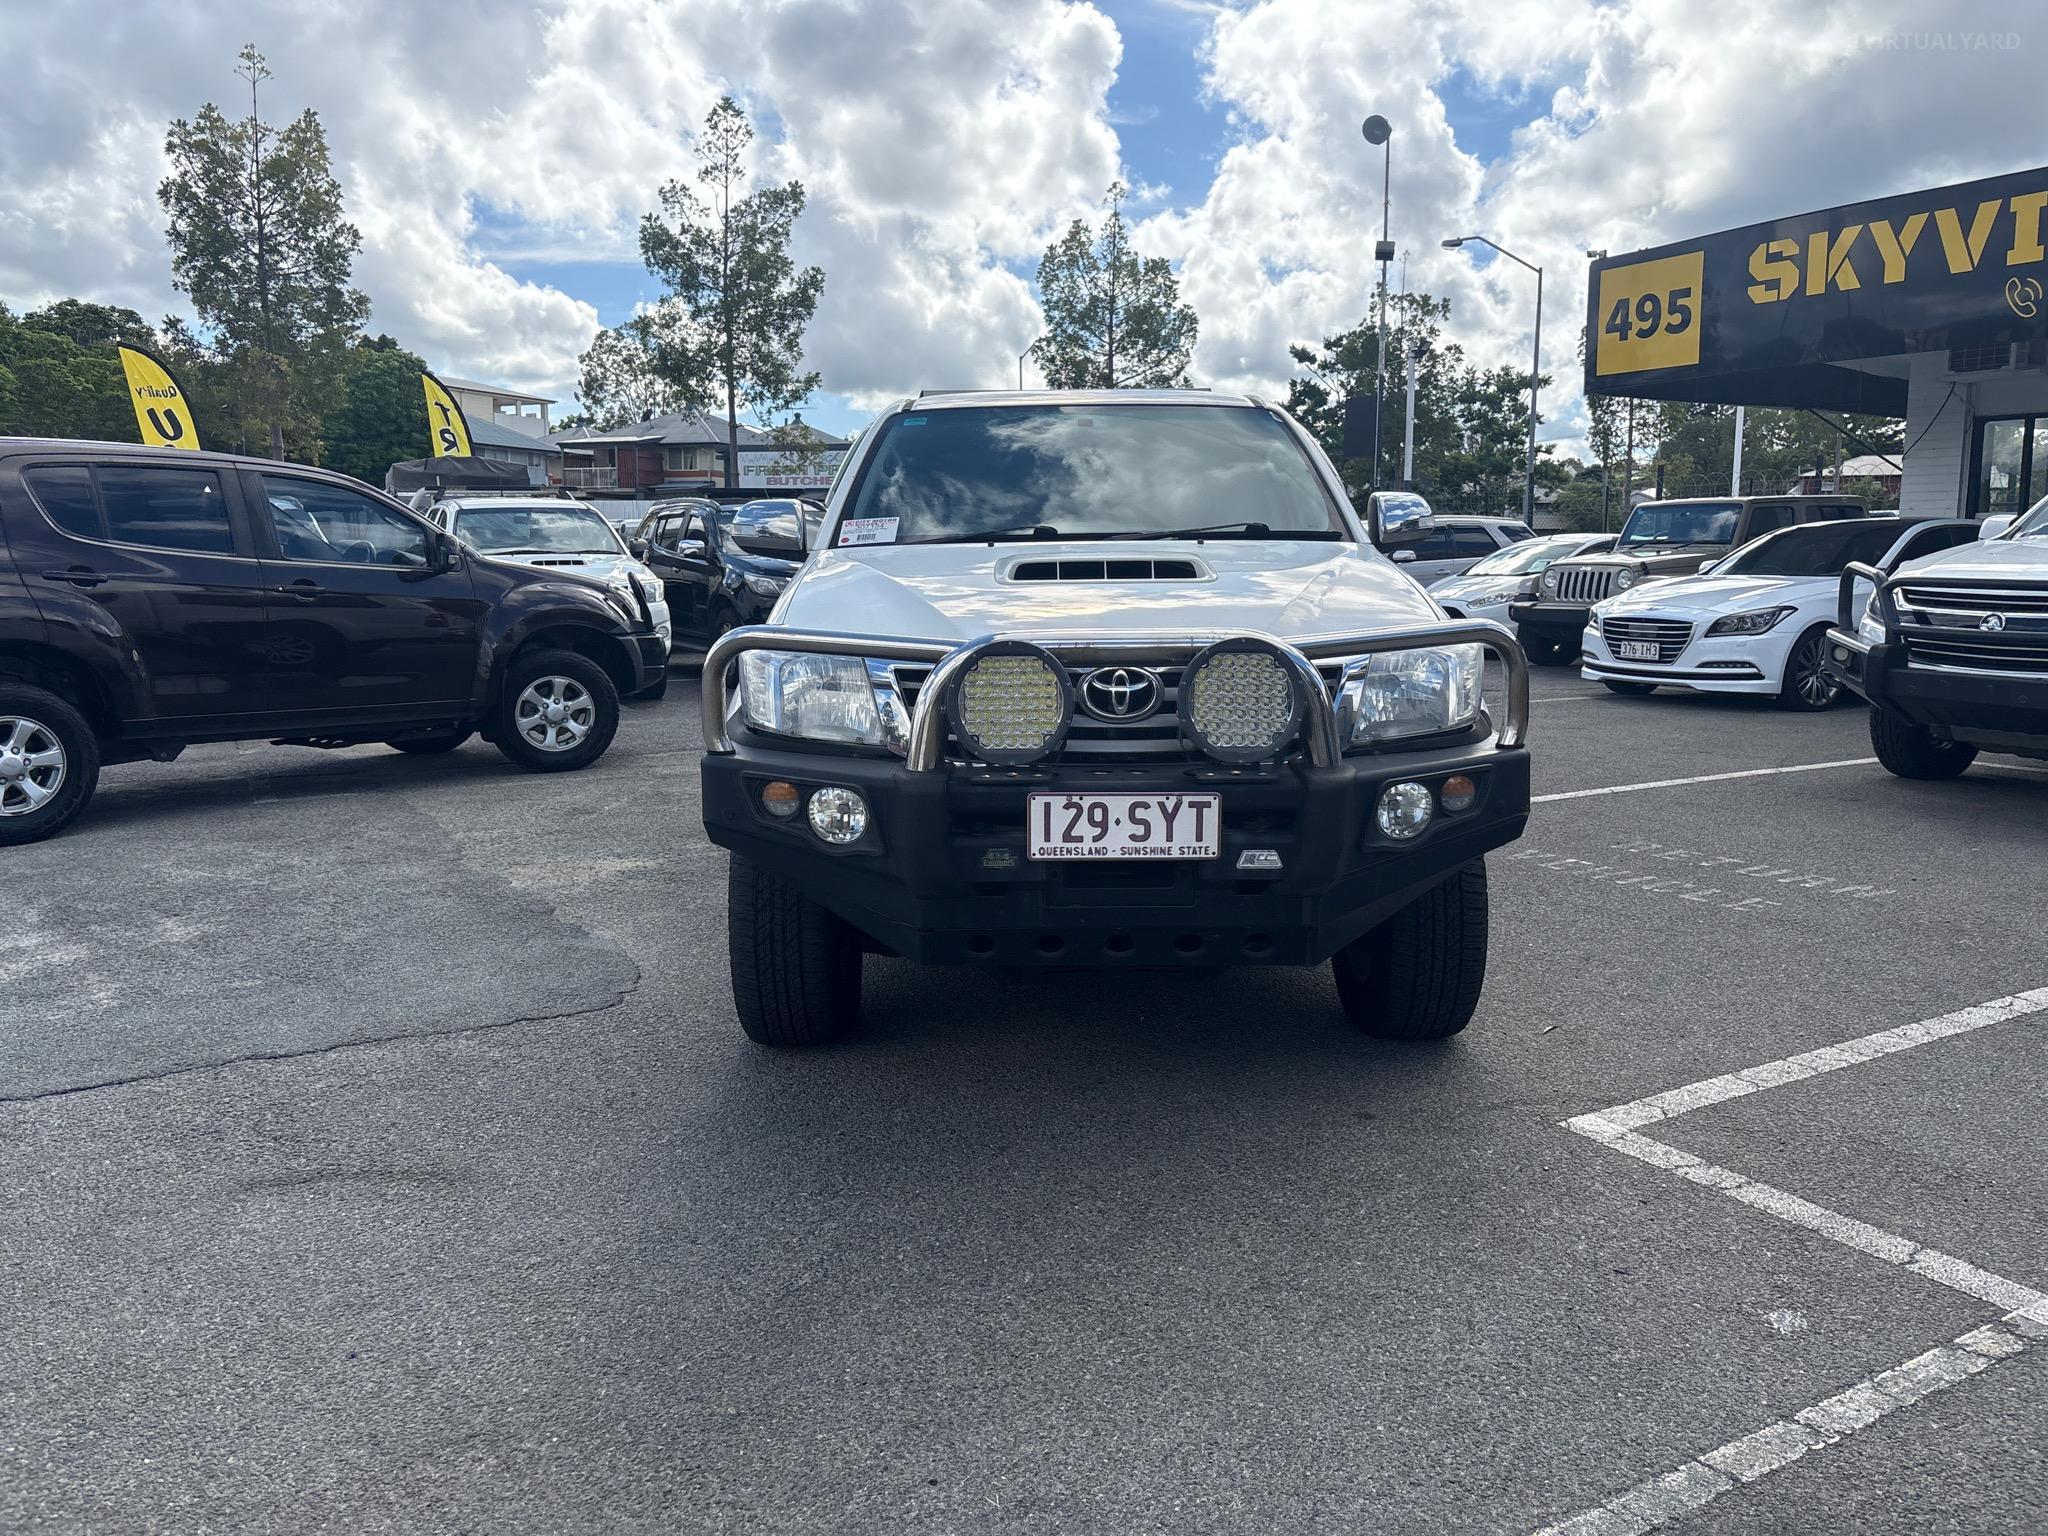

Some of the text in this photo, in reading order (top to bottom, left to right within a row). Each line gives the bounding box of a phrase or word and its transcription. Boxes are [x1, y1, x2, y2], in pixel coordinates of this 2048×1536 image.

[1604, 286, 1693, 342] 495
[1038, 845, 1108, 857] QUEENSLAND
[1119, 845, 1173, 856] SUNSHINE
[1178, 845, 1210, 856] STATE
